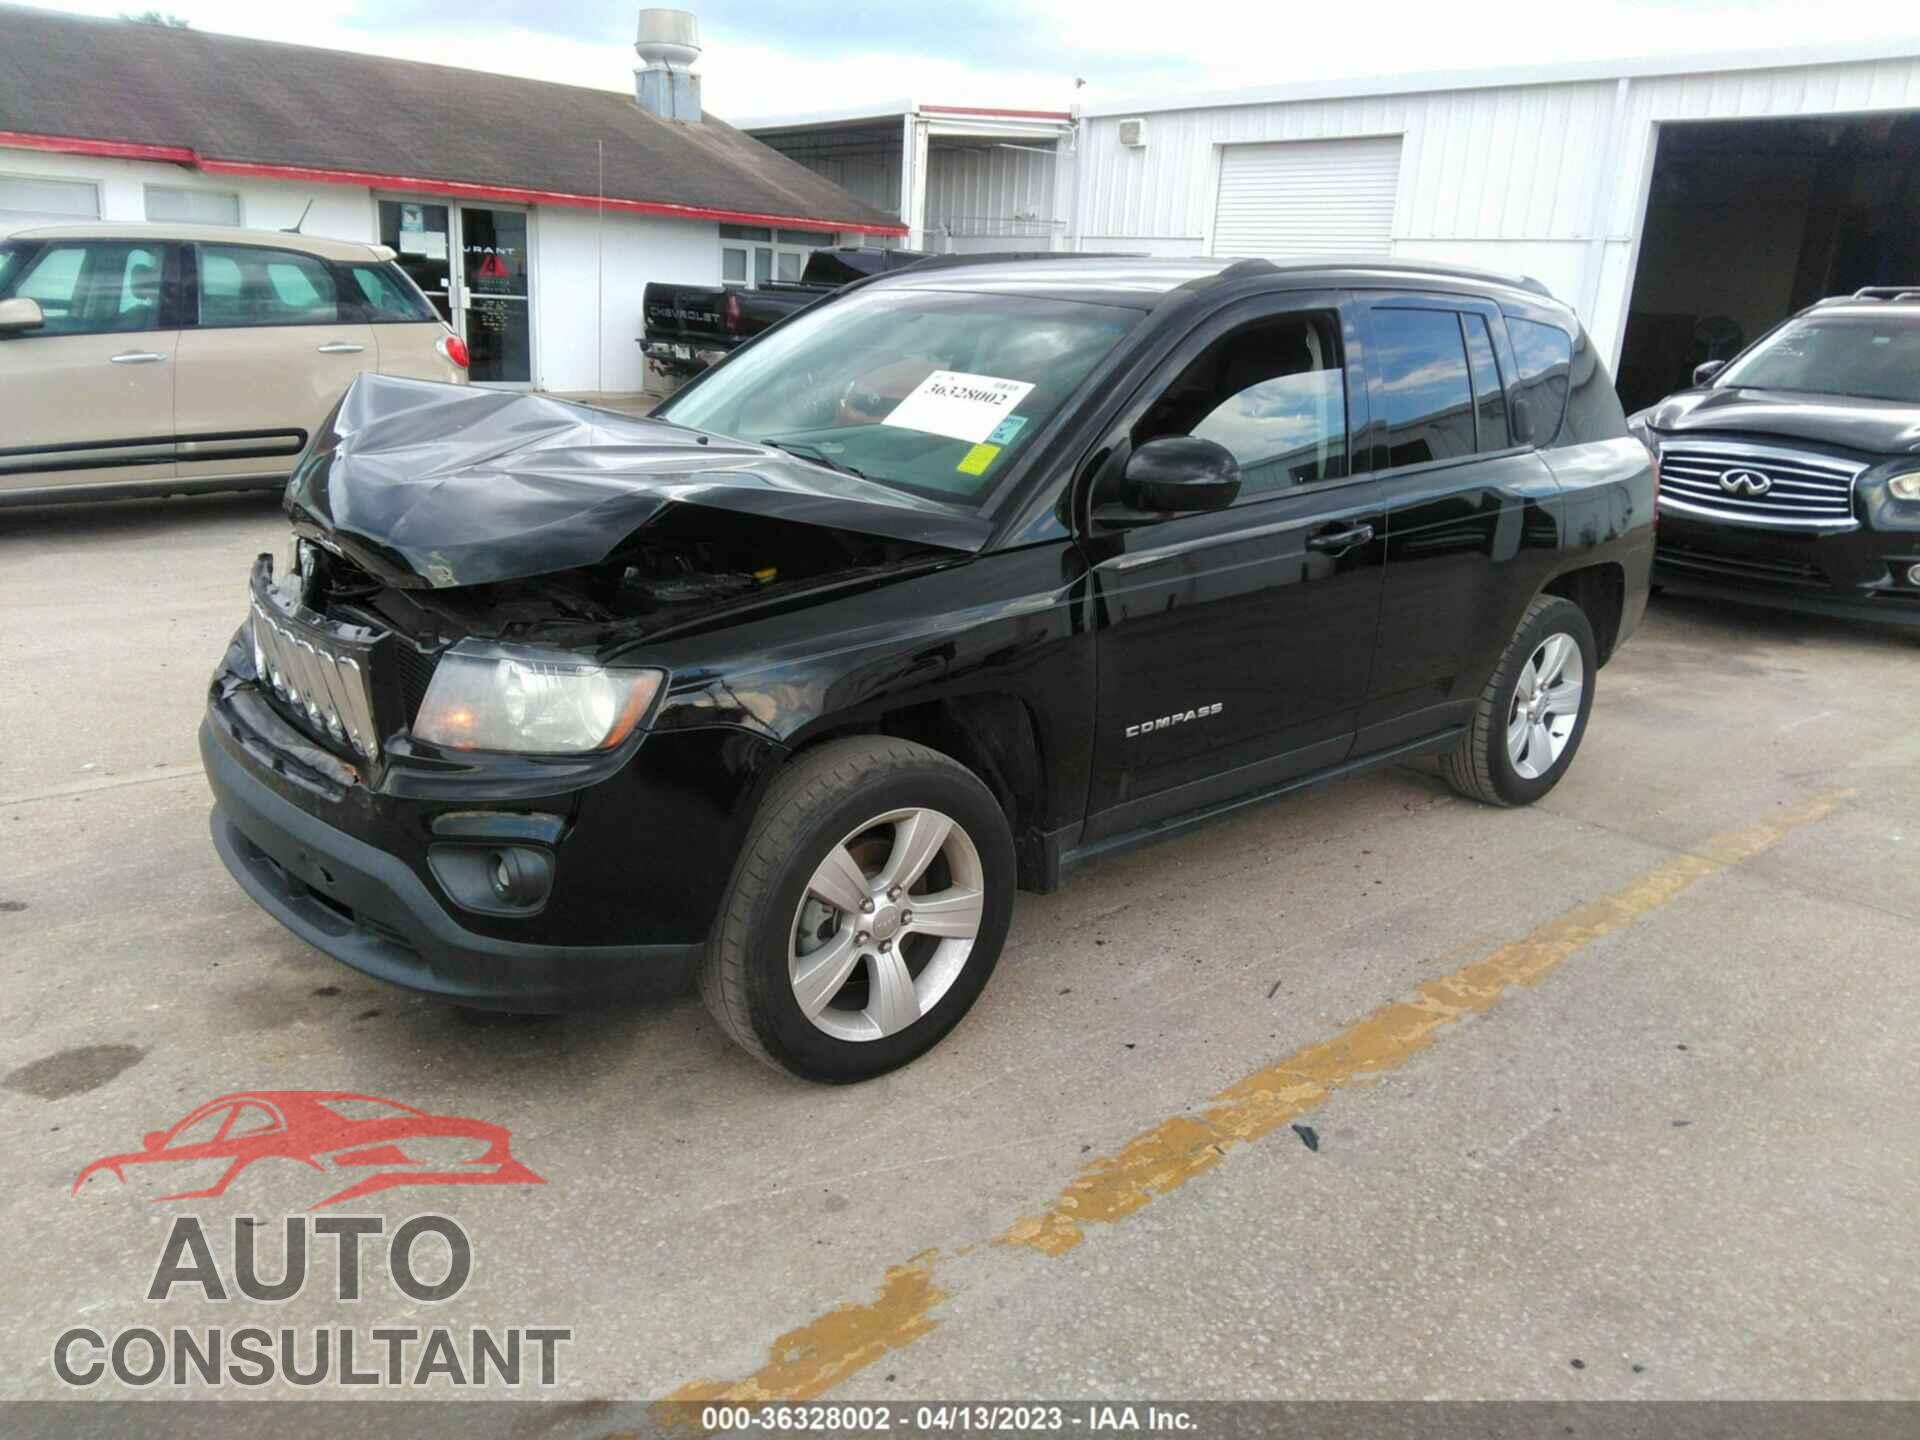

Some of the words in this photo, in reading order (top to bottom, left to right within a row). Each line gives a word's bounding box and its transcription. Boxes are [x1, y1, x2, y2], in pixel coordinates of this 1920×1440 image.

[649, 305, 720, 322] CHEVROLET
[925, 383, 1008, 405] 36328002
[1126, 702, 1223, 738] COMPASS
